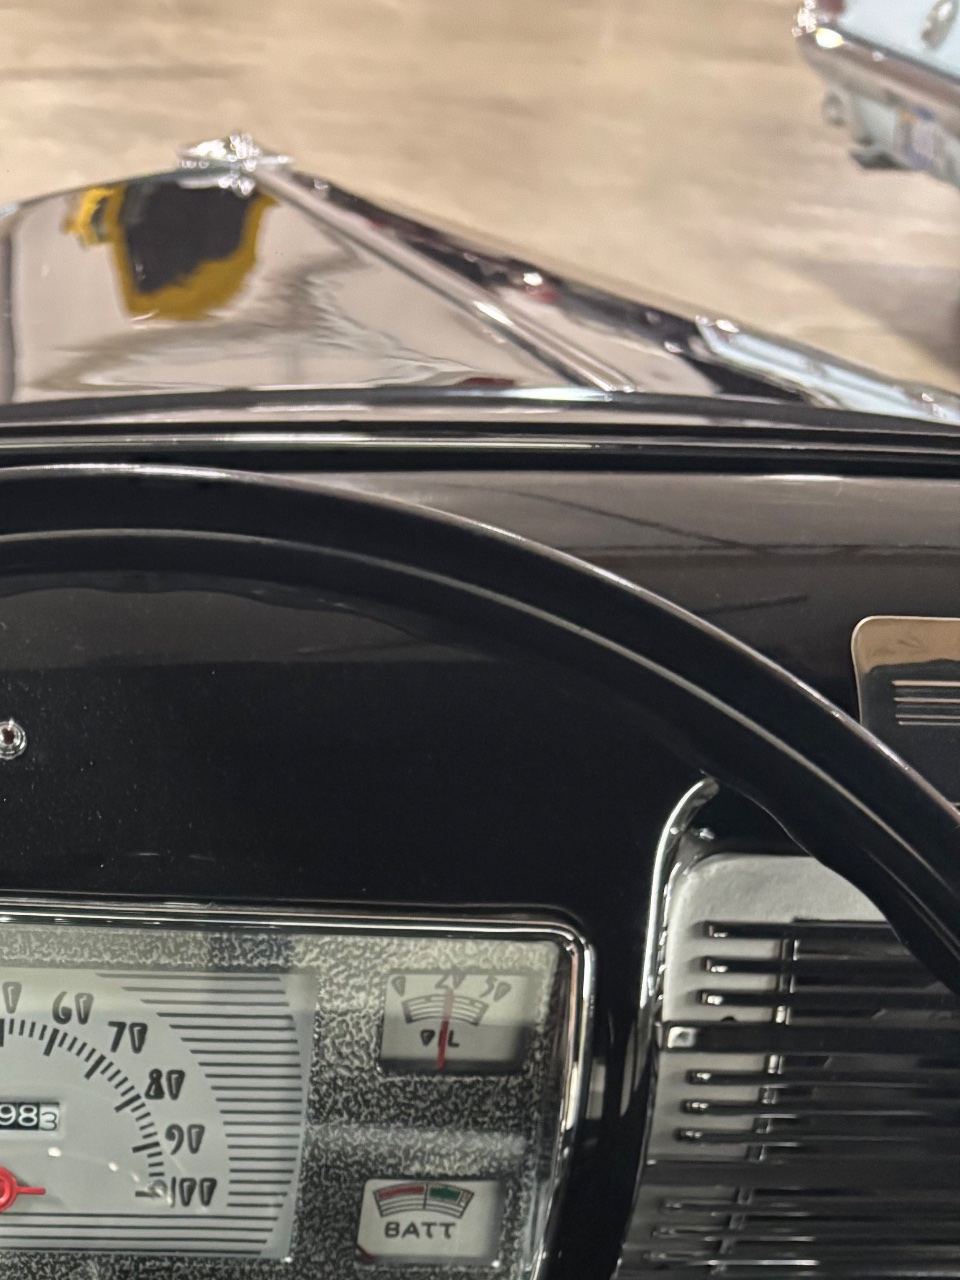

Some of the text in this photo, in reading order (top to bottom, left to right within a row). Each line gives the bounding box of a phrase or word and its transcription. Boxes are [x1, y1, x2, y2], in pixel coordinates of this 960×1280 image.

[51, 991, 94, 1025] 60
[107, 1021, 148, 1054] 70
[144, 1068, 186, 1101] 80
[164, 1123, 206, 1156] 90
[169, 1176, 218, 1208] 100
[384, 1221, 457, 1240] BATT
